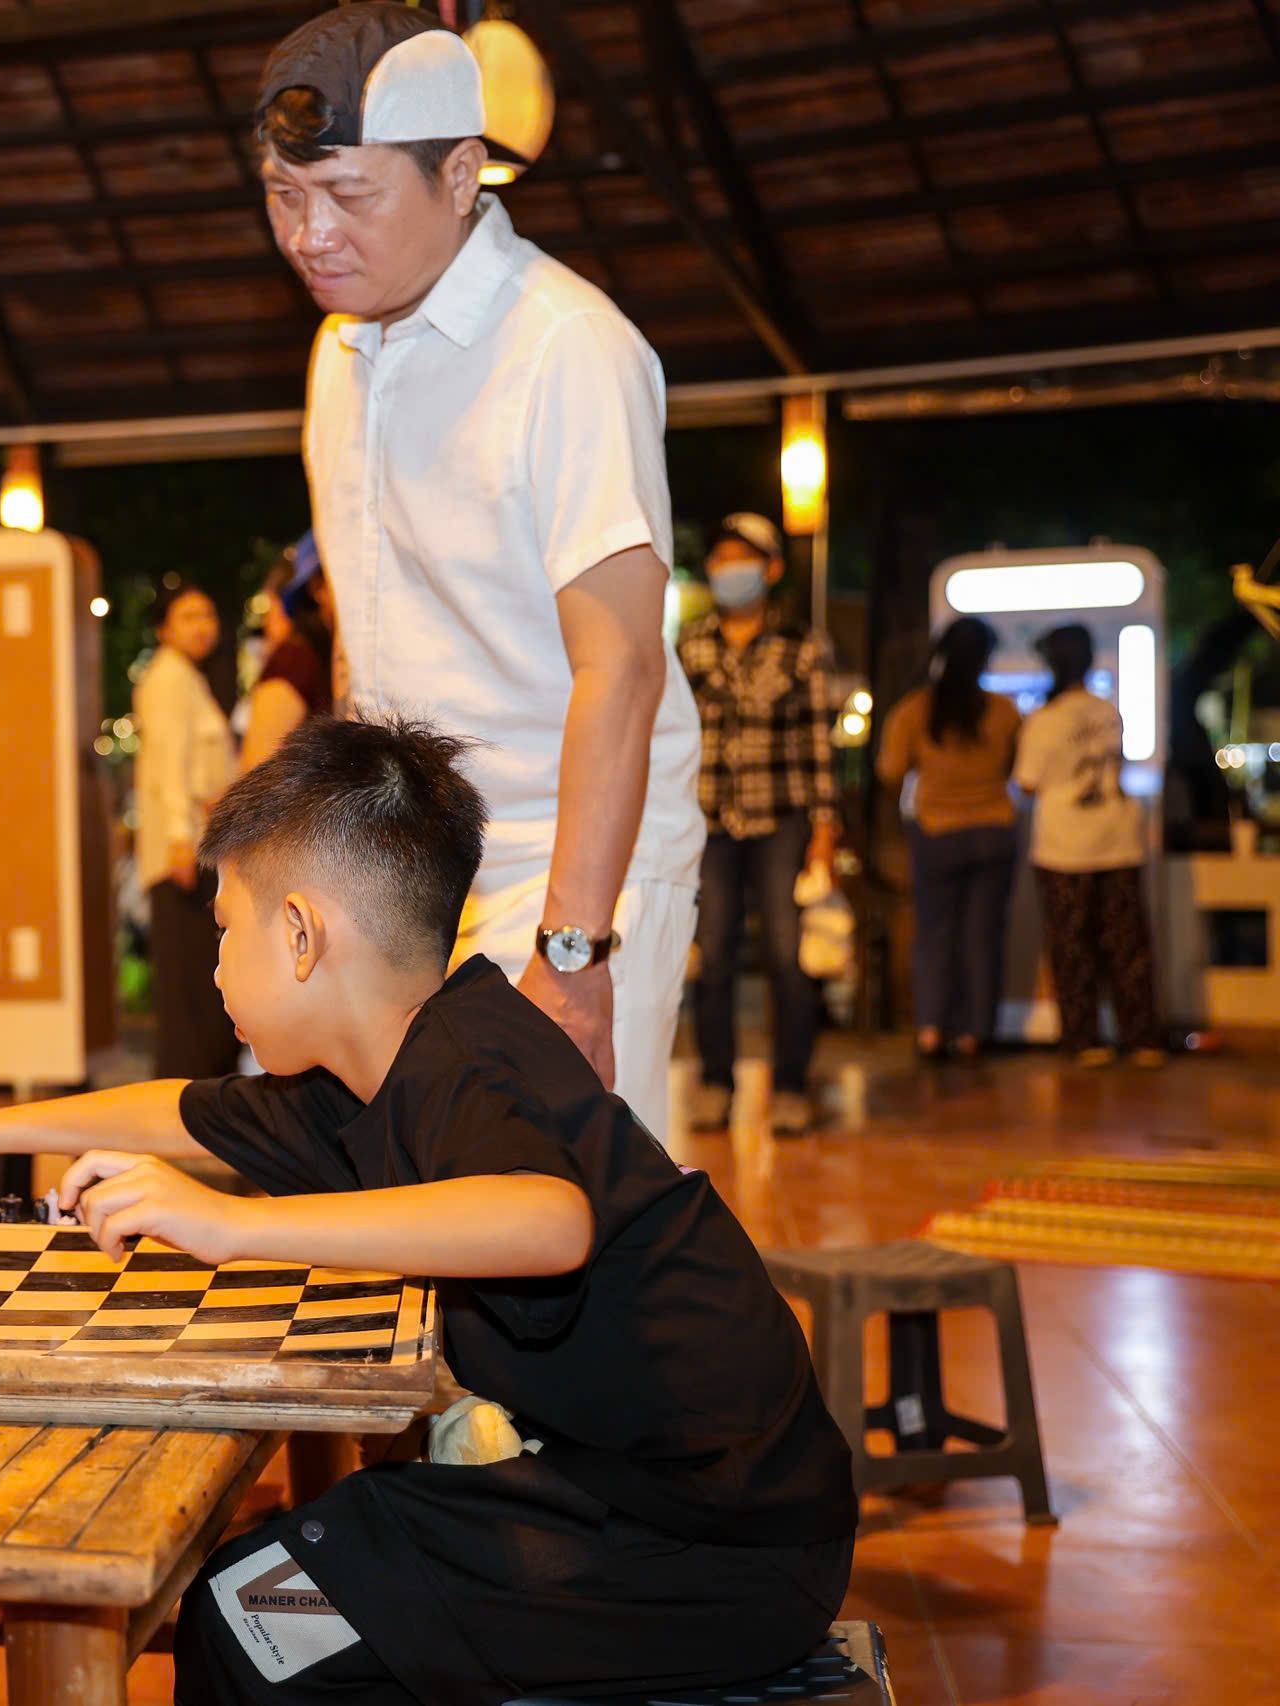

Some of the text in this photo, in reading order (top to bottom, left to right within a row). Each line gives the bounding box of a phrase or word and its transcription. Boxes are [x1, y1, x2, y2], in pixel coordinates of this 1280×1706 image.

[248, 1595, 296, 1606] MANER
[251, 1614, 285, 1665] Popular Style
